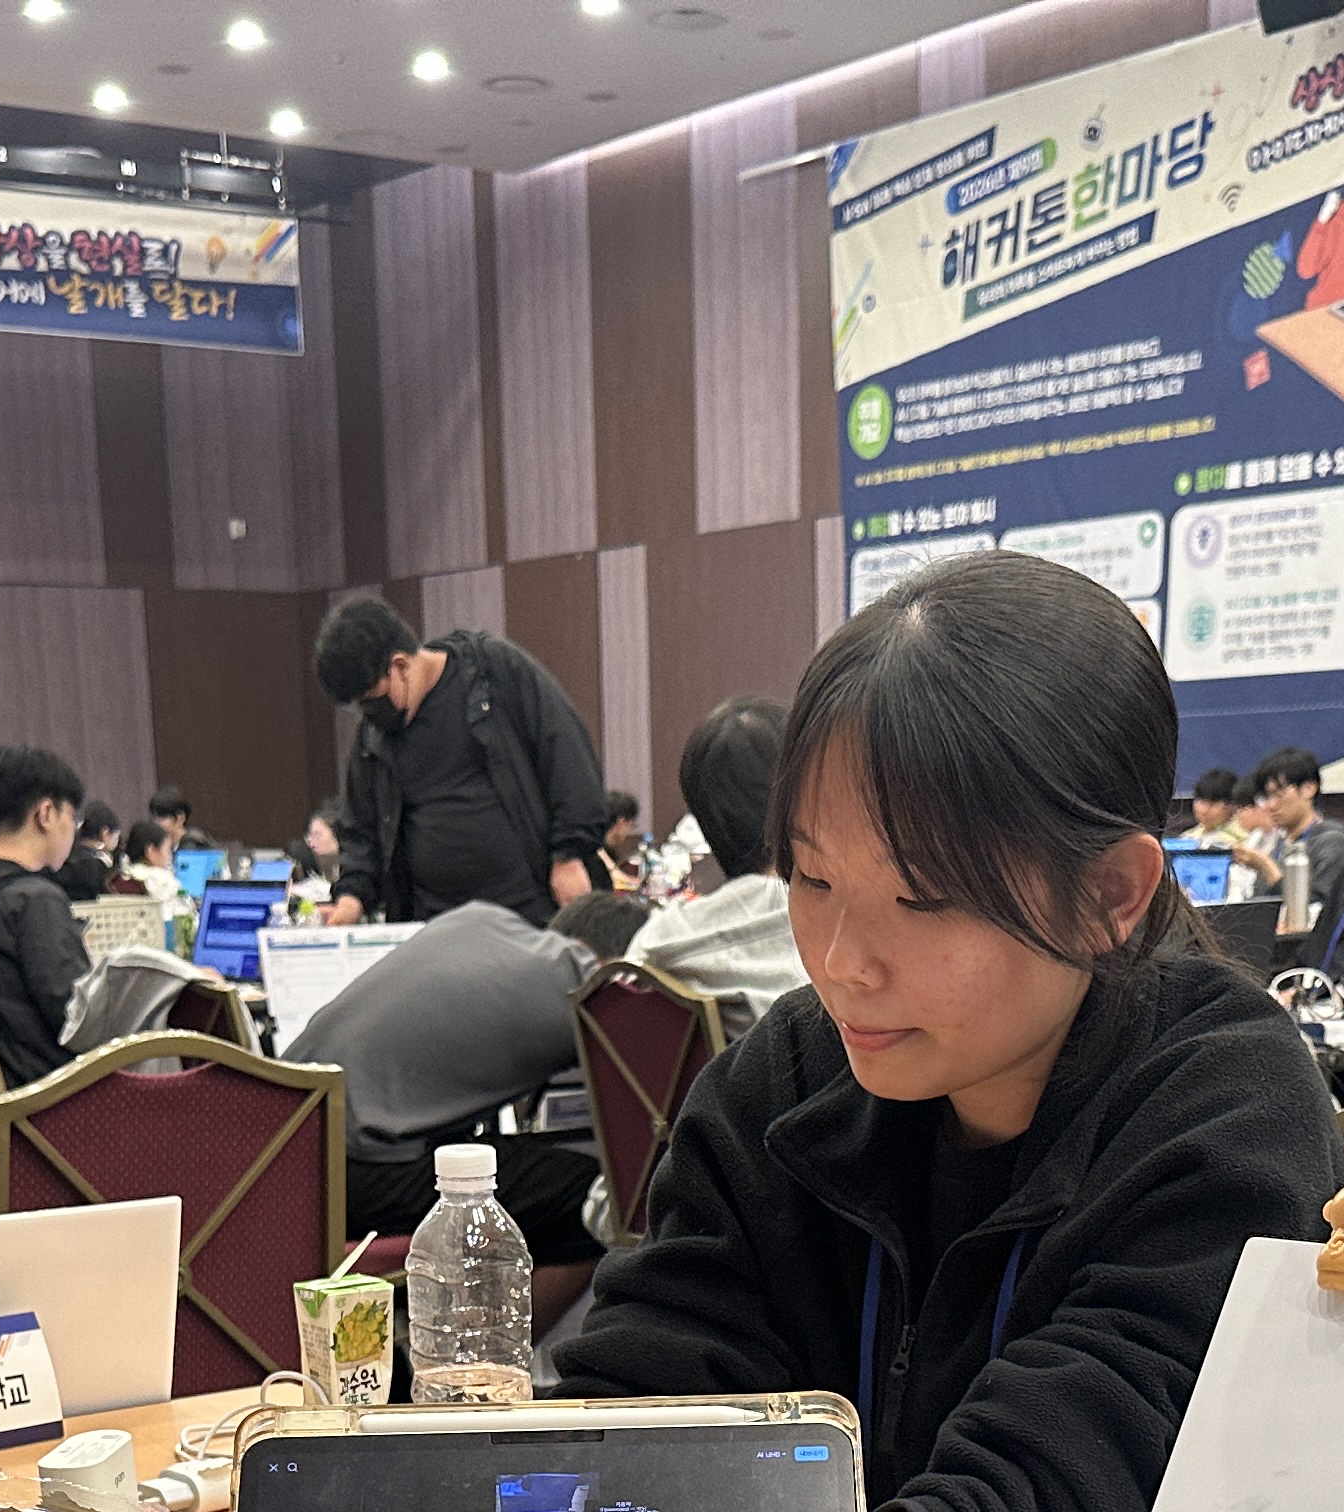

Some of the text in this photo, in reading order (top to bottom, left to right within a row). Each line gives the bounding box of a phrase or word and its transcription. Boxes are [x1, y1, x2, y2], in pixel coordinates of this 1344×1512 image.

[48, 273, 148, 320] 날개를
[152, 280, 238, 322] 달다!
[340, 1365, 381, 1397] 과수원
